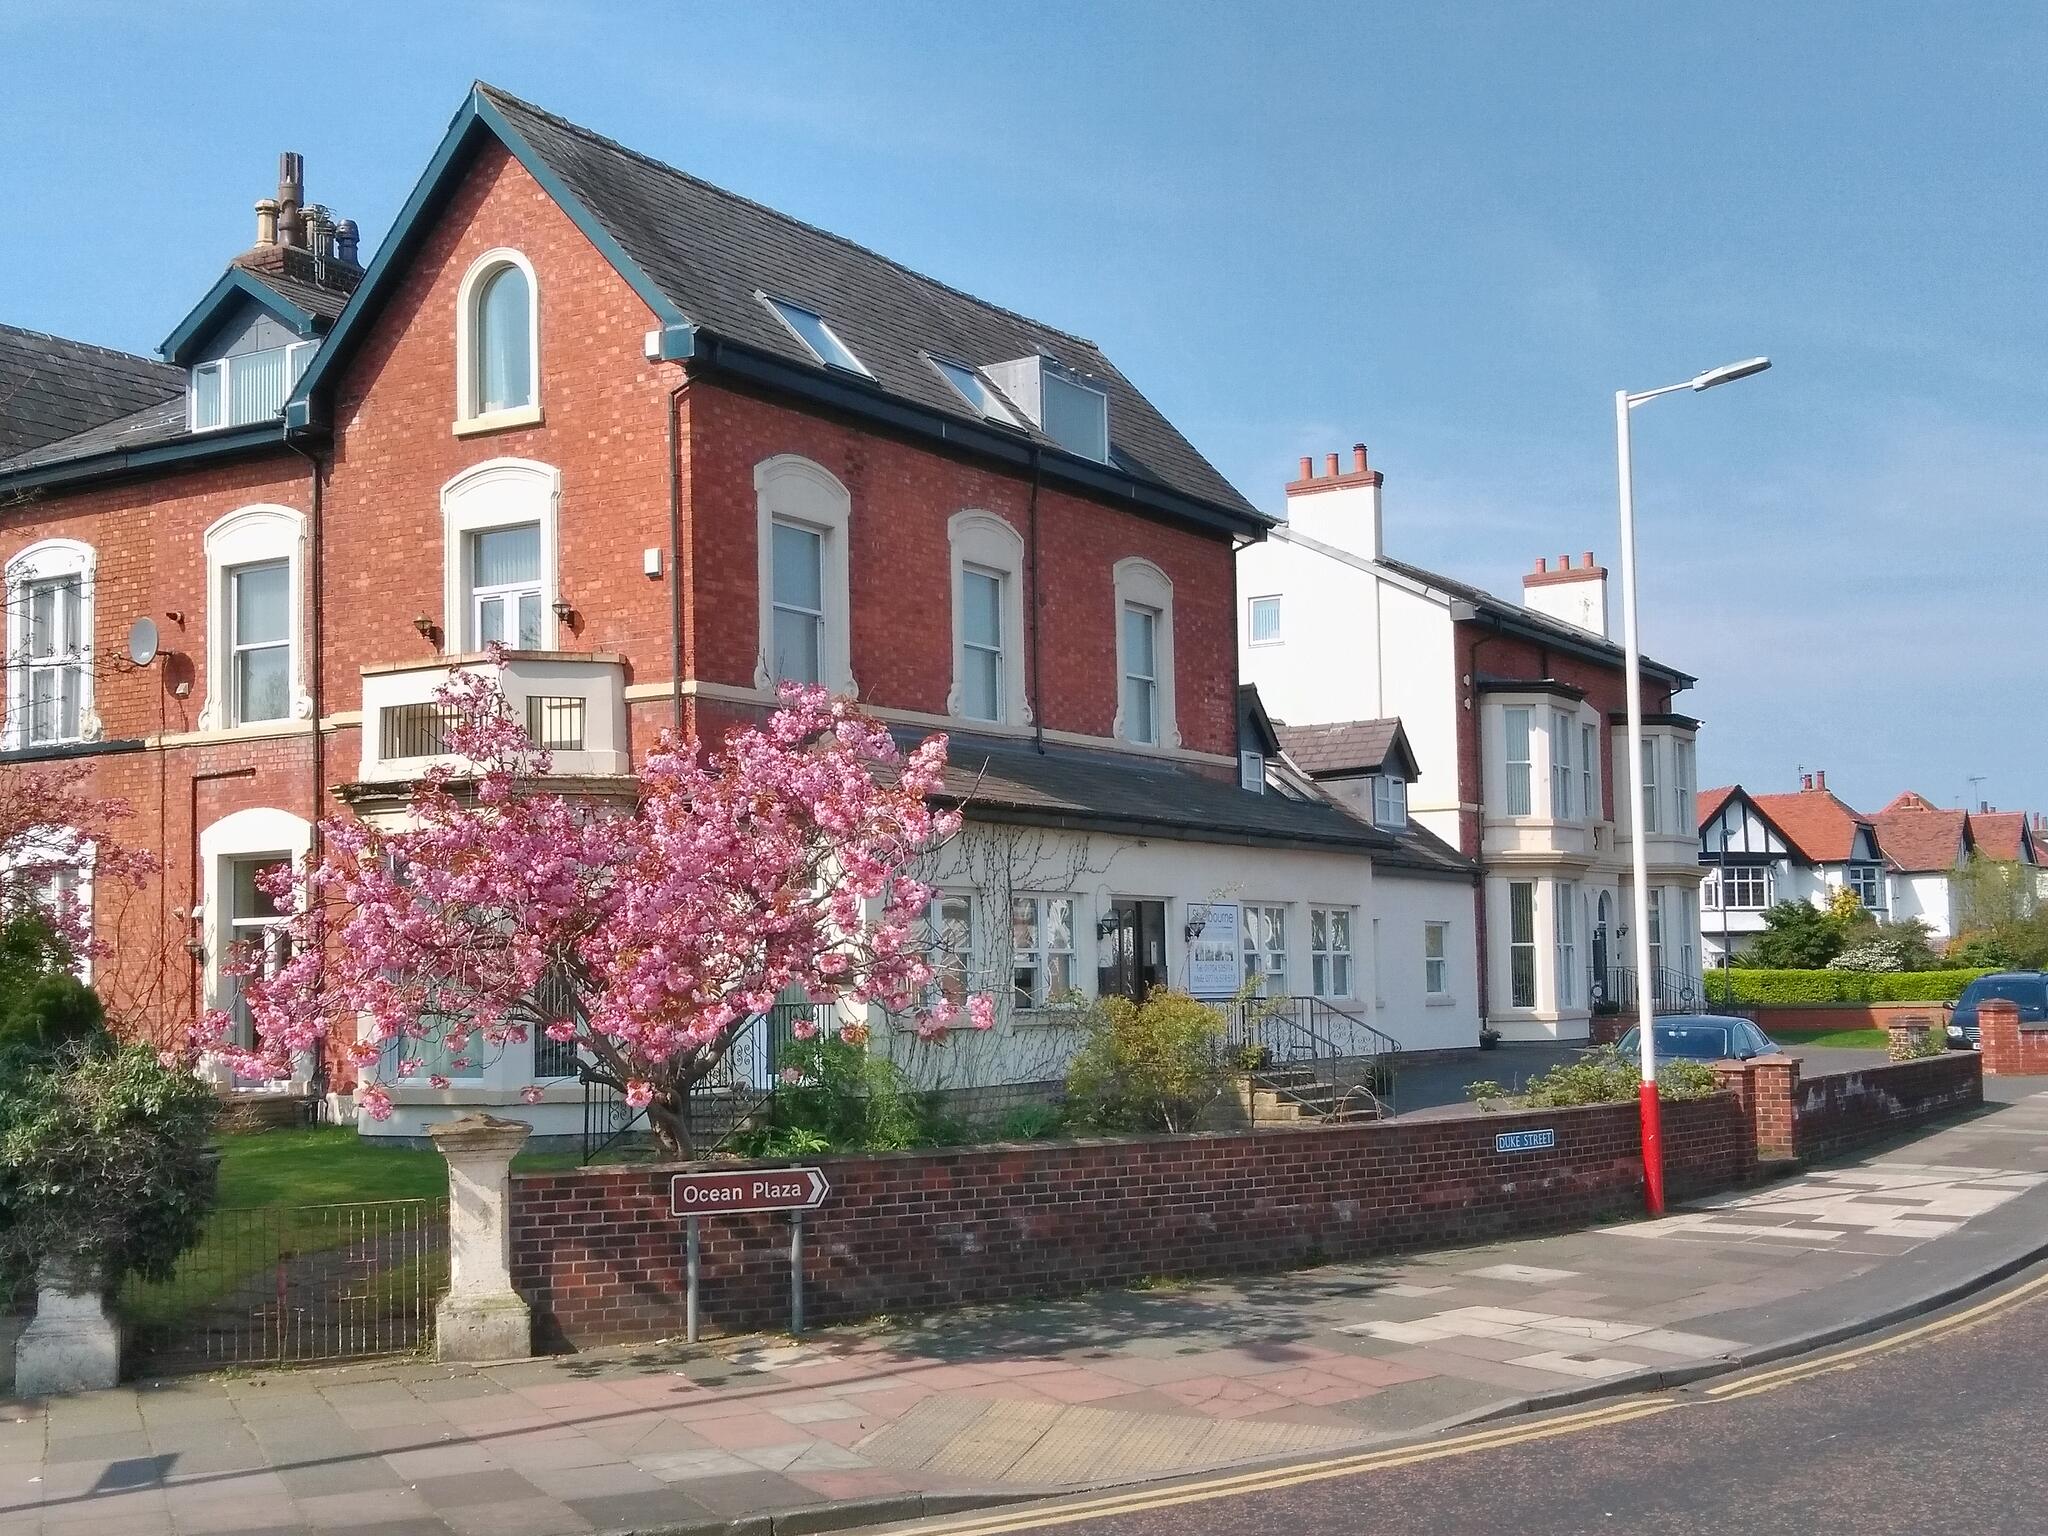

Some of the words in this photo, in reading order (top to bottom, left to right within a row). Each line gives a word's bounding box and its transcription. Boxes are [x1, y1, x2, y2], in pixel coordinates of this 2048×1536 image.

[1192, 908, 1233, 924] Sbourne
[1499, 1135, 1520, 1149] DUKE
[1523, 1132, 1551, 1146] STREET
[683, 1185, 742, 1203] Ocean
[752, 1181, 801, 1199] Plaza
